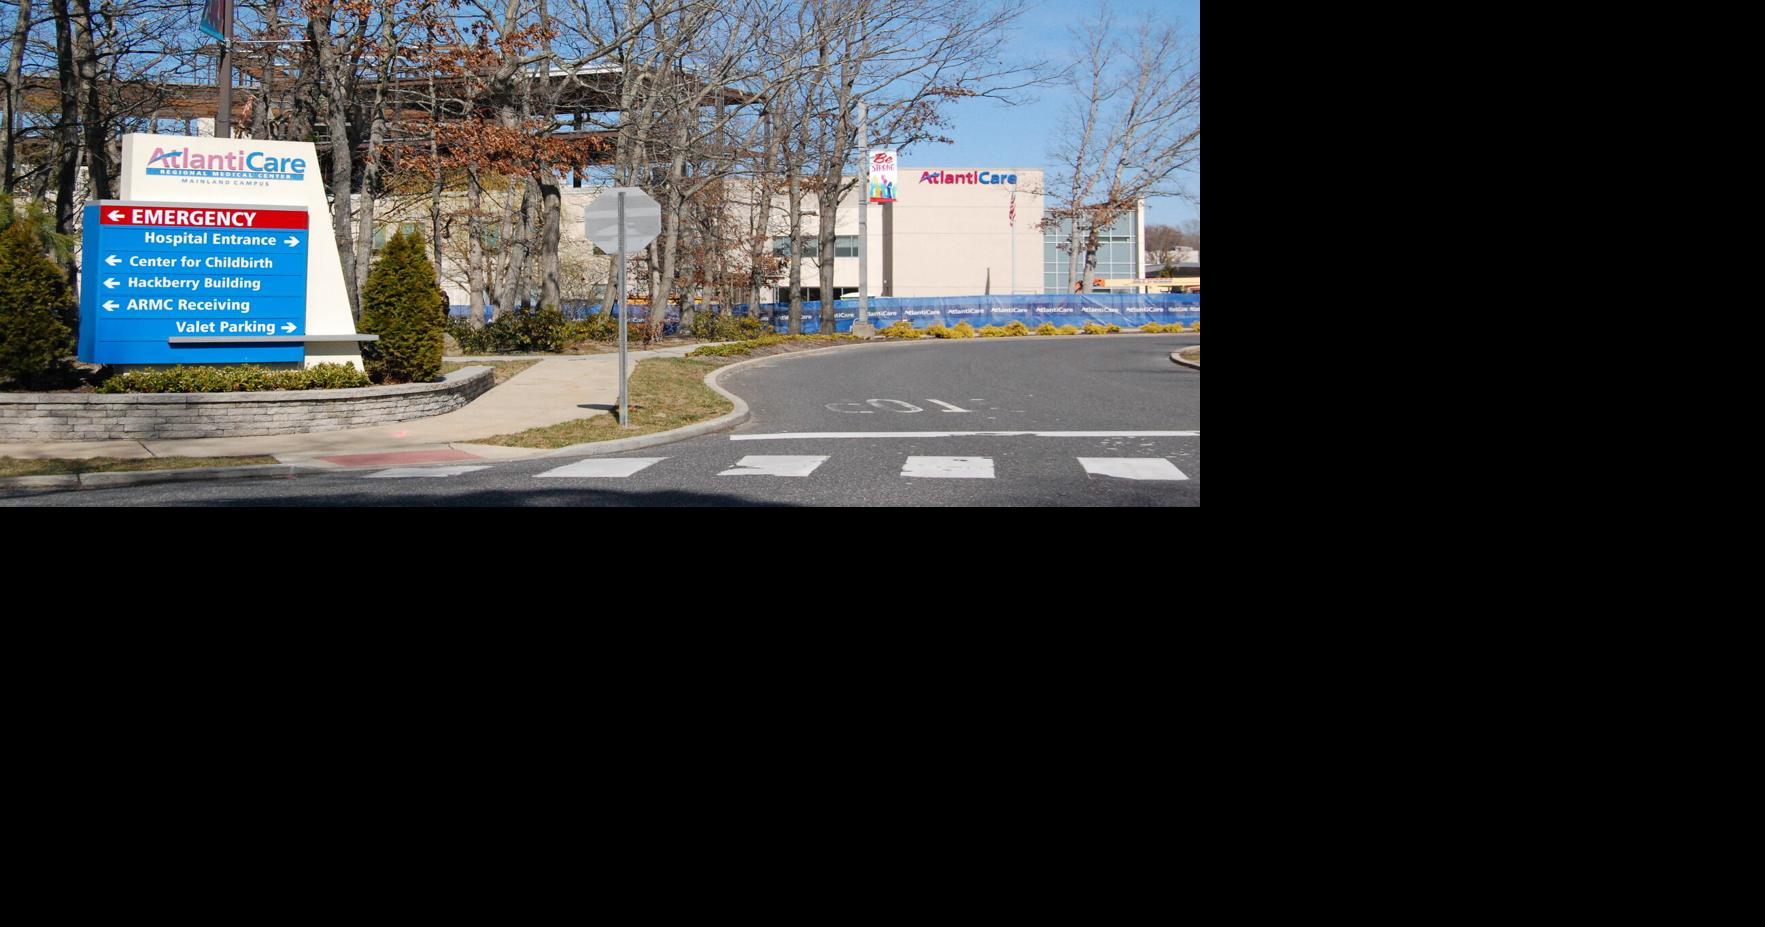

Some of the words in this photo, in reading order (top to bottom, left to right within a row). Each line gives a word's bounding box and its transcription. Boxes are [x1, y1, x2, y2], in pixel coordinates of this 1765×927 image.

[147, 147, 306, 174] AtlantiCare
[873, 152, 893, 164] Be
[159, 169, 208, 177] REGIONAL
[212, 171, 253, 179] MEDICAL
[919, 170, 1018, 185] AtlantiCare
[181, 178, 231, 186] MAINLAND
[131, 208, 257, 227] EMERGENCY
[144, 231, 208, 247] Hospital
[212, 233, 277, 246] Entrance
[129, 255, 177, 268] Center
[180, 255, 201, 268] for
[205, 256, 273, 269] Childbirth
[127, 277, 200, 291] Hackberry
[204, 277, 261, 291] Building
[126, 299, 173, 311] ARMC
[178, 299, 250, 313] Receiving
[175, 321, 216, 333] Valet
[220, 321, 276, 335] Parking
